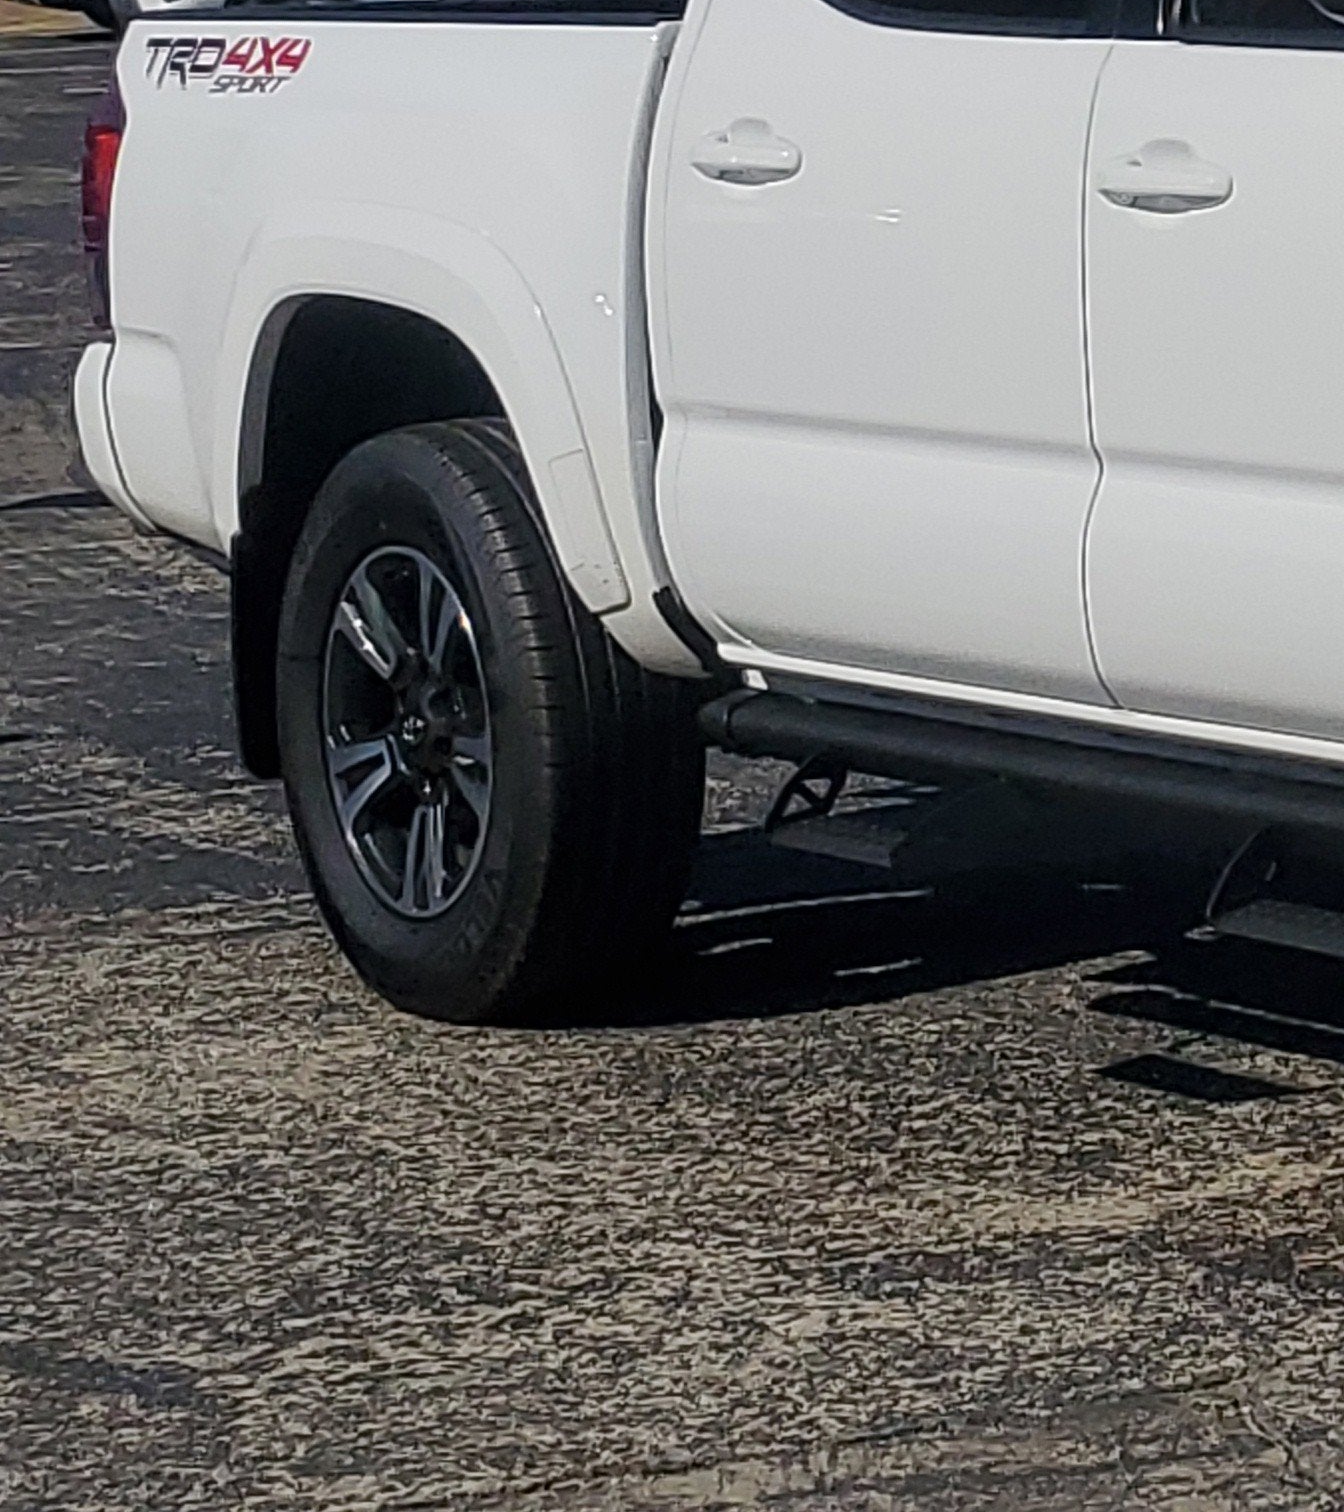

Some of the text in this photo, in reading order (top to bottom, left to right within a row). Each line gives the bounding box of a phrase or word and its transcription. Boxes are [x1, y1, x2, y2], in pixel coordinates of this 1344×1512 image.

[145, 36, 313, 90] TRD 4X4
[208, 74, 291, 94] SPORT
